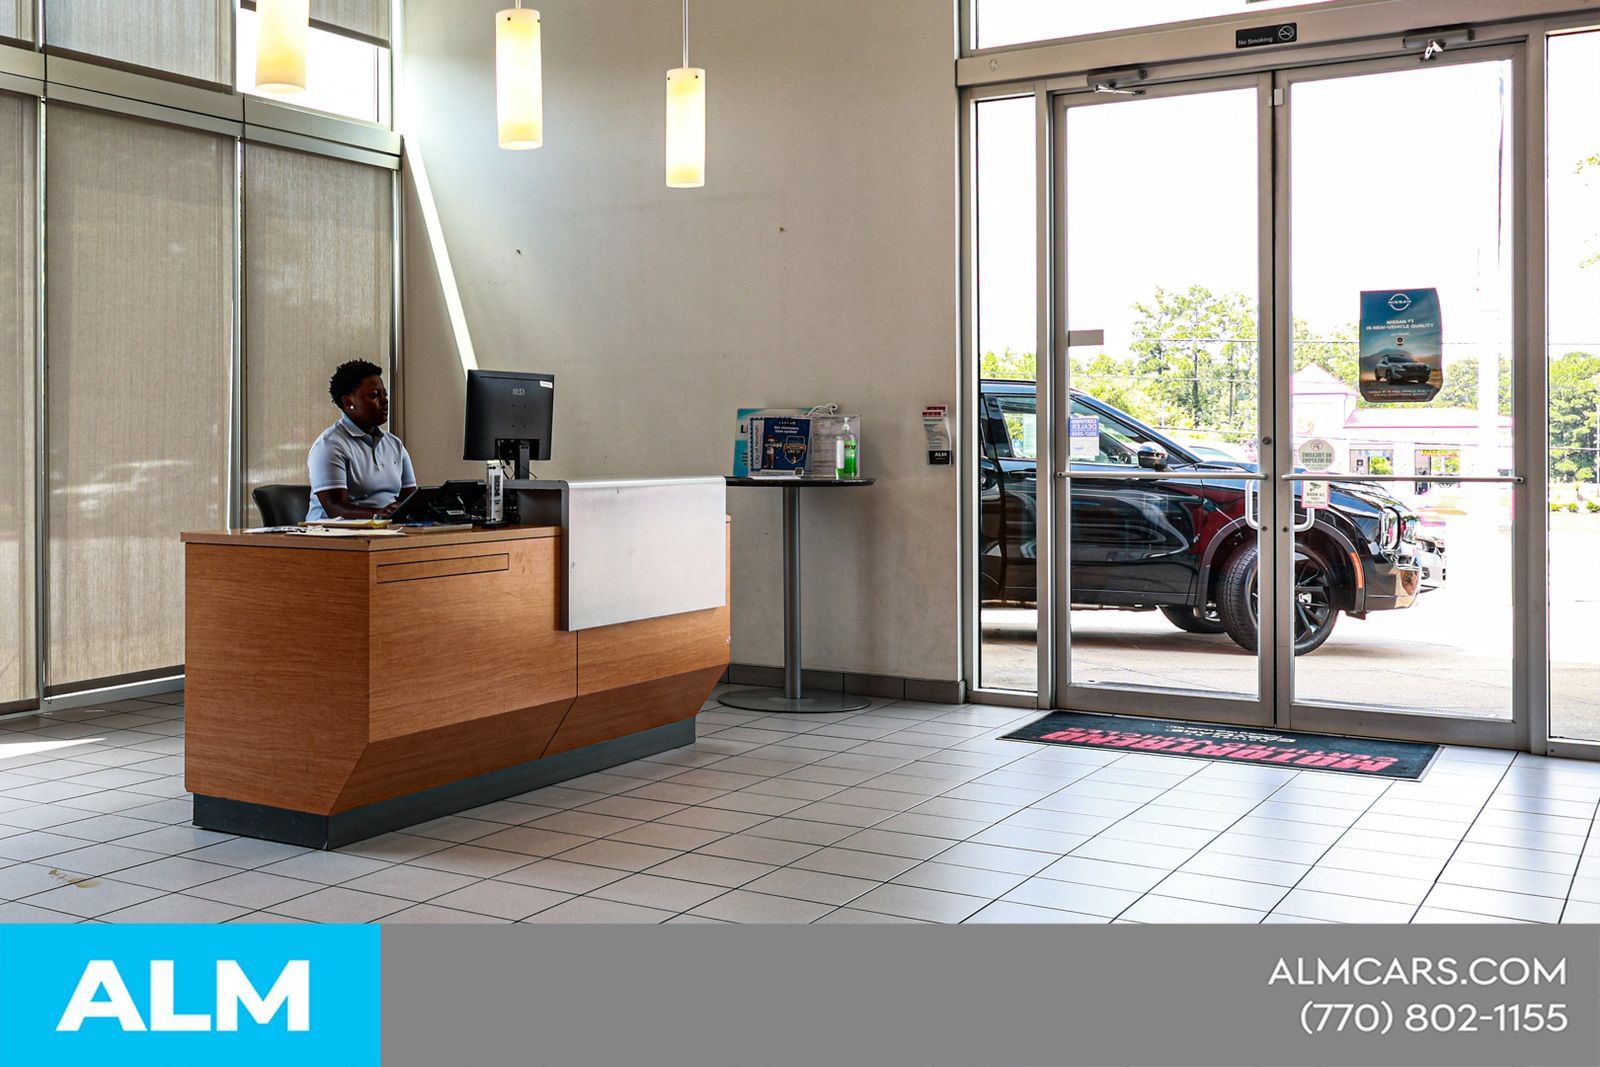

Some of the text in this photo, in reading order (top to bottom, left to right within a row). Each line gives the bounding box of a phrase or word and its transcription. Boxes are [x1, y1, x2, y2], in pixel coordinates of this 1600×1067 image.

[1065, 727, 1212, 745] VEHICLES
[1040, 730, 1393, 772] MOTORTREND
[1221, 742, 1399, 763] CERTIFIED
